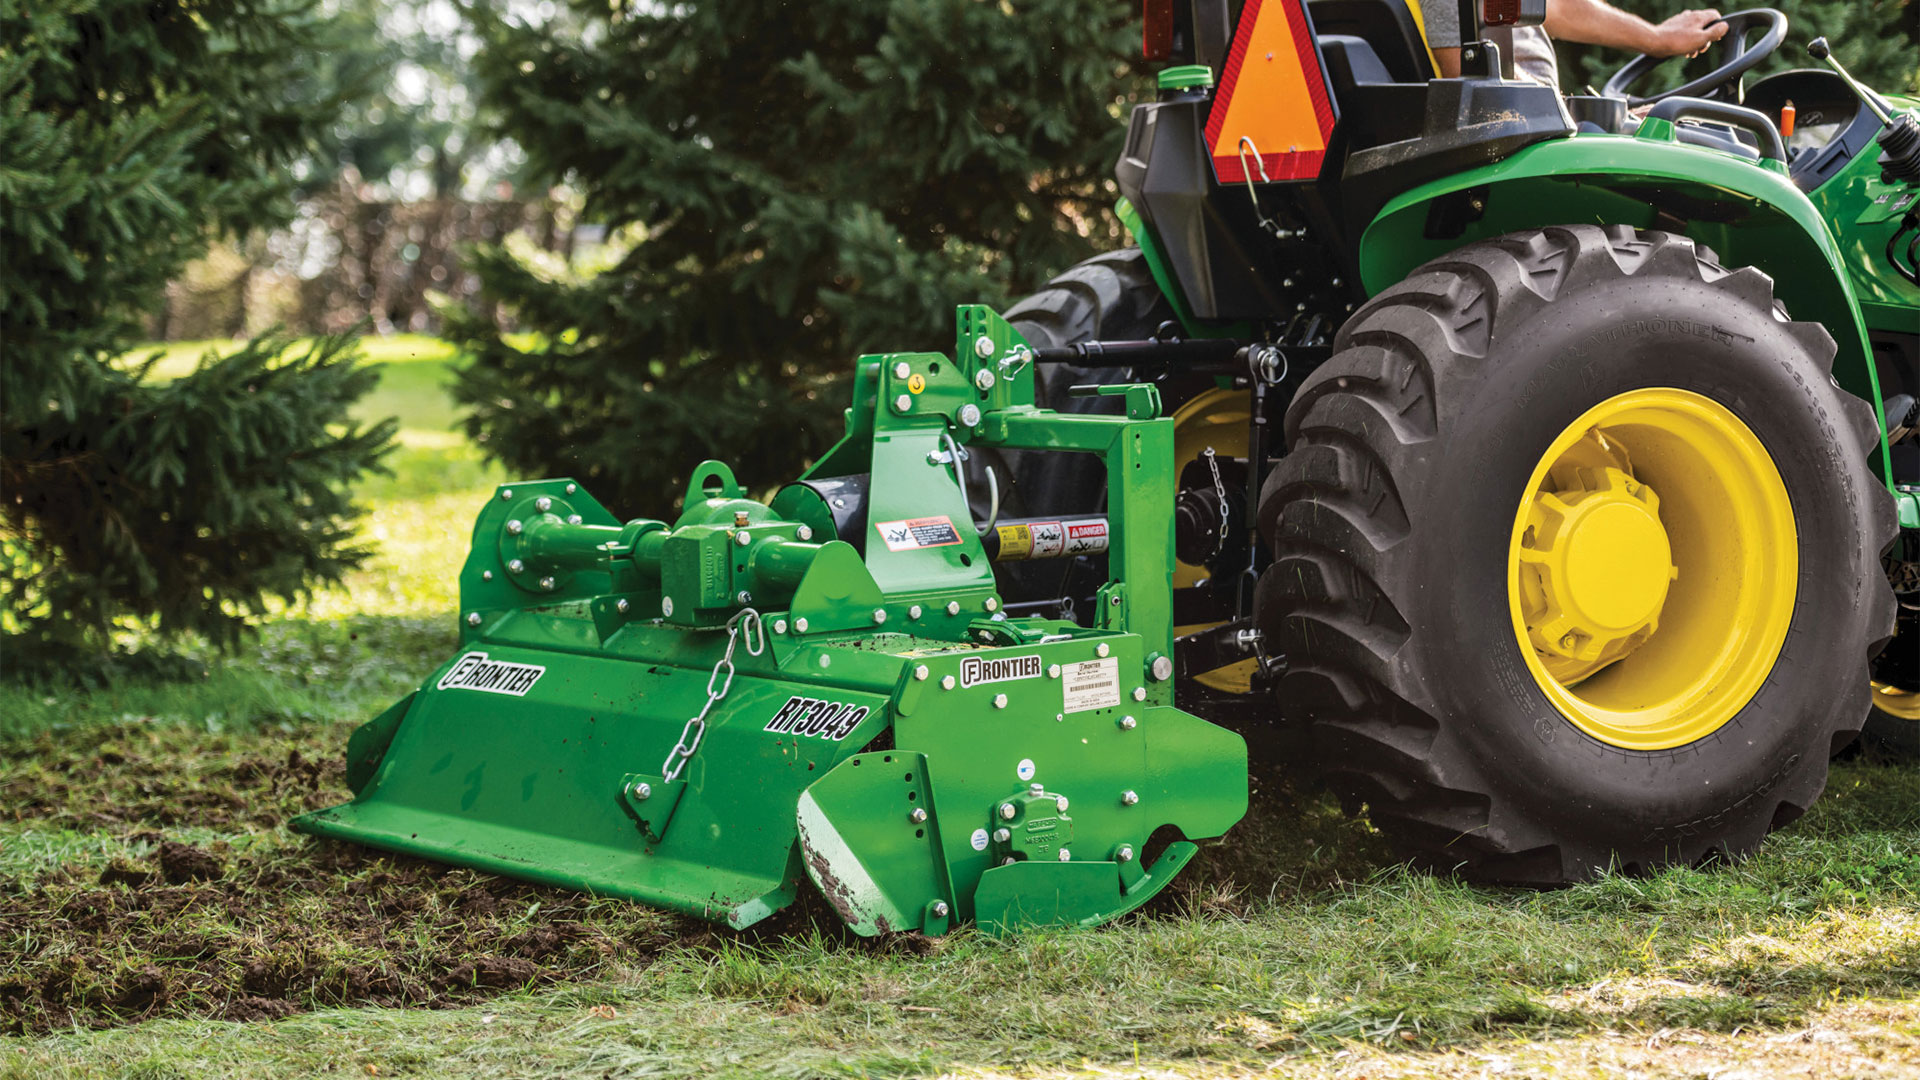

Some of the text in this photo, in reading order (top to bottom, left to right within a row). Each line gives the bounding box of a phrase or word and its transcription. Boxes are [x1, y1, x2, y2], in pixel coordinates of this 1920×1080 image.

[1078, 525, 1105, 537] DANGER
[441, 655, 542, 693] FRONTIER
[962, 656, 1040, 685] FRONTIER
[765, 696, 868, 740] RT3049
